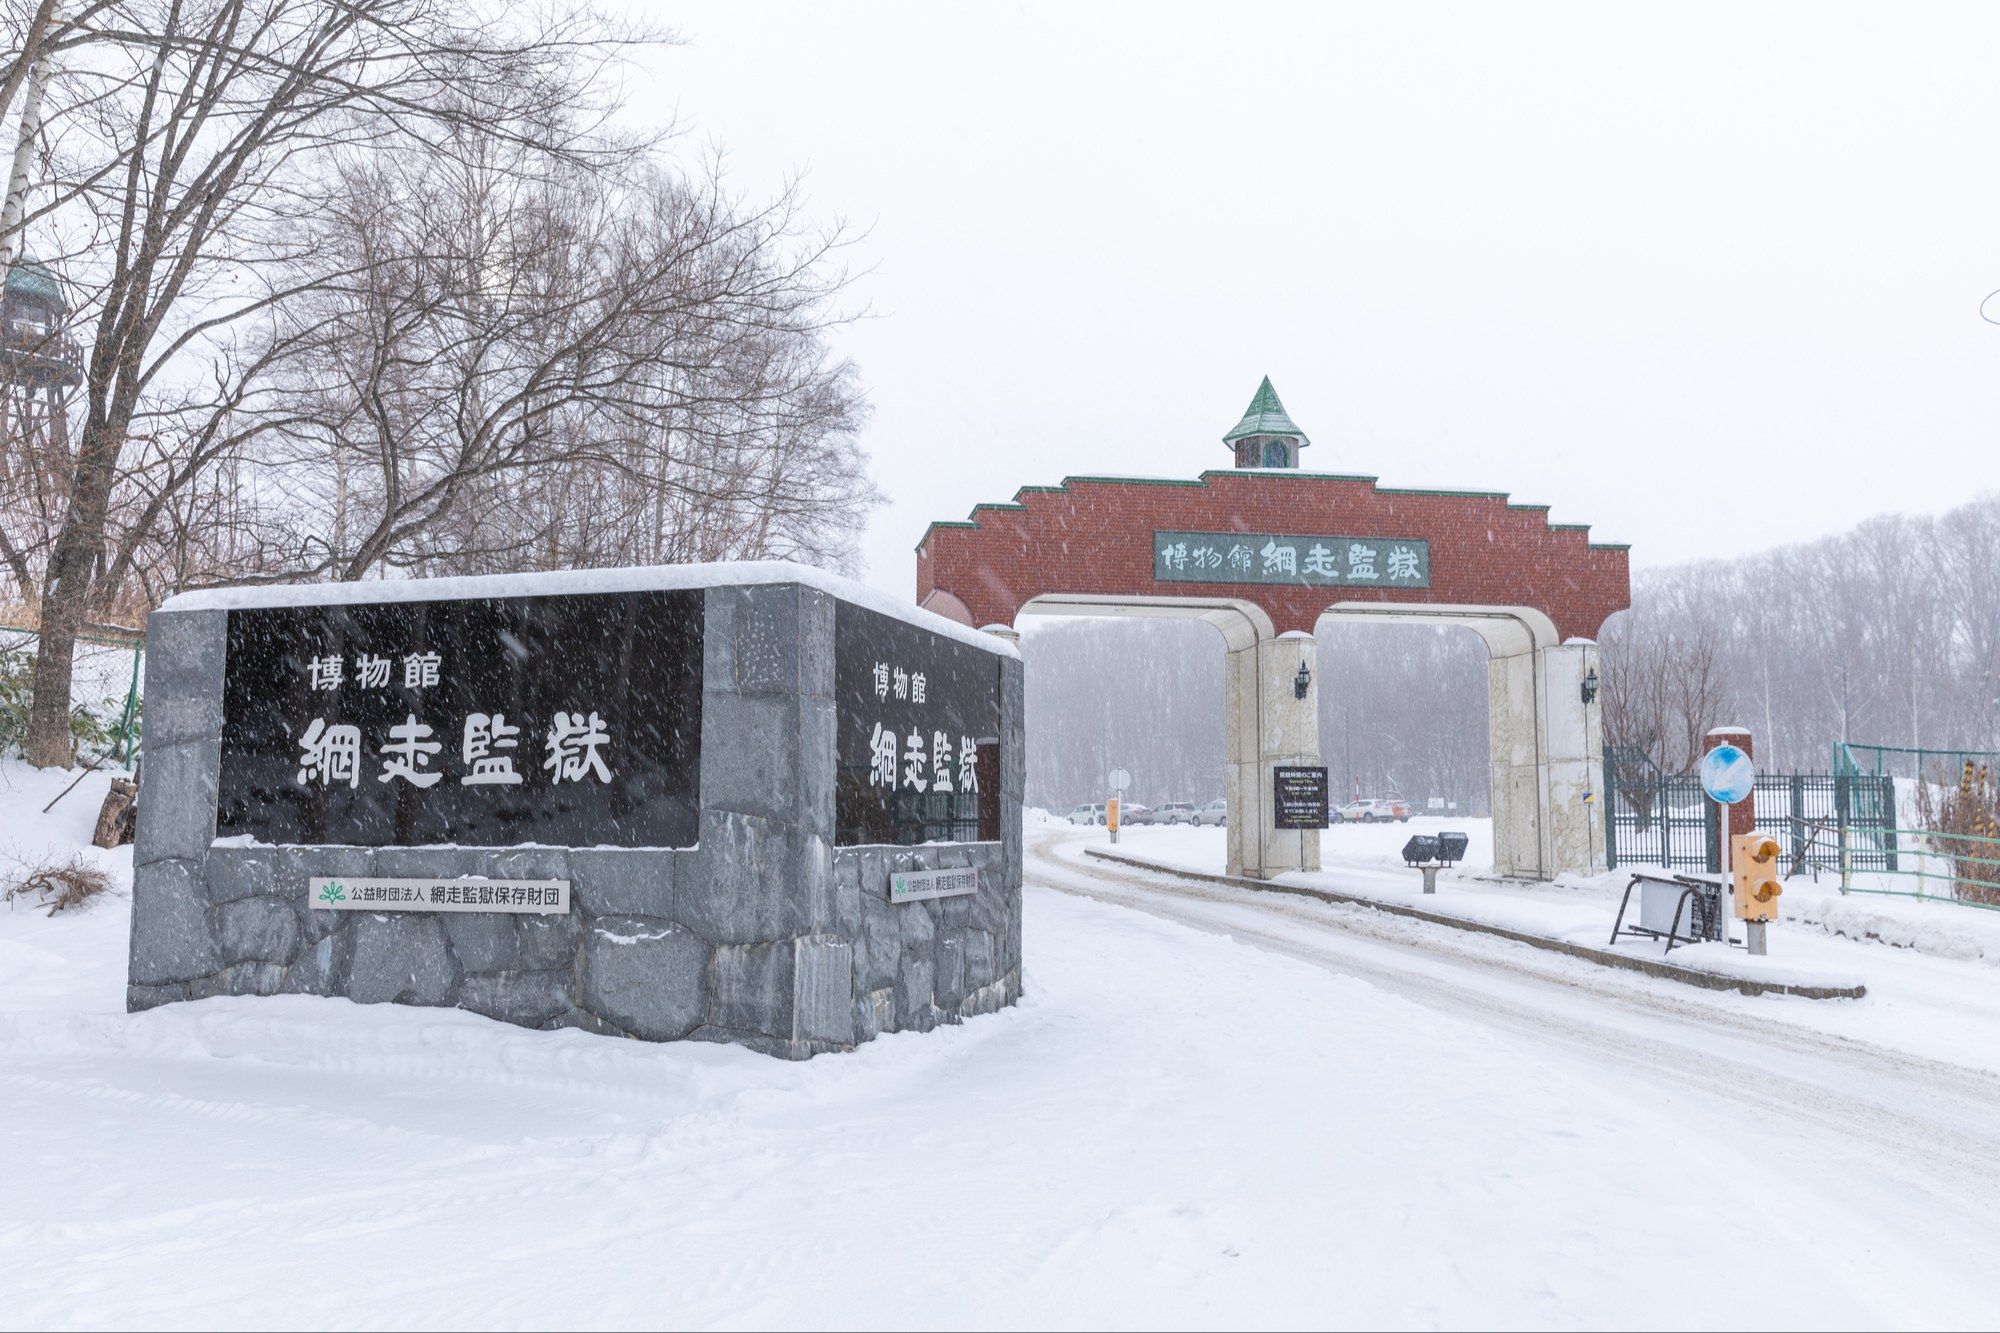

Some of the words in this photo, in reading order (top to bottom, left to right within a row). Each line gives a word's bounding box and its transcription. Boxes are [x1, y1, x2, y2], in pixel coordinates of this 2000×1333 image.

[306, 651, 442, 691] 博物館
[873, 661, 927, 704] 博物館
[297, 711, 612, 789] 網走監獄
[869, 721, 979, 793] 網走監獄
[351, 887, 425, 902] 公益財団法人
[430, 886, 559, 906] 網走監獄保存財団
